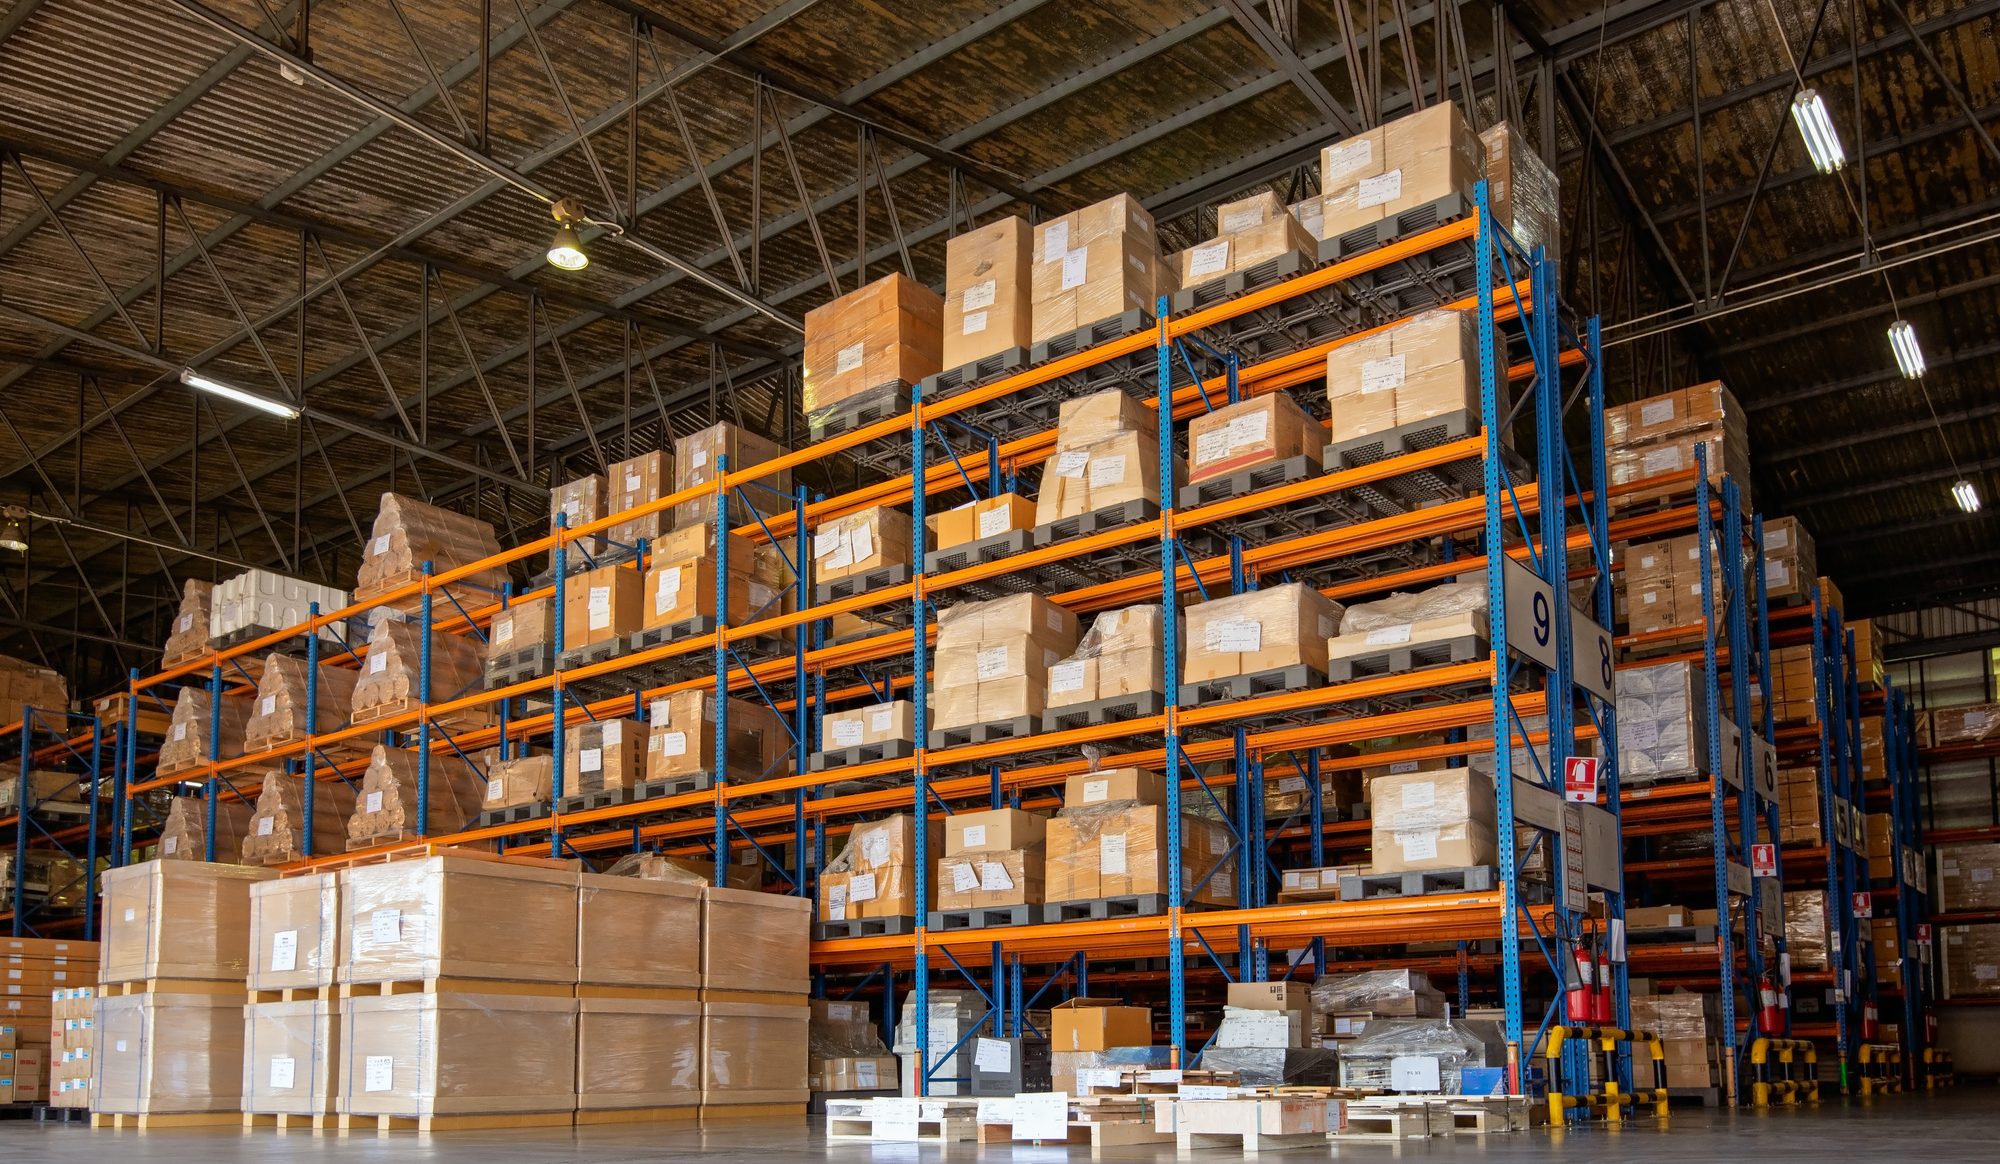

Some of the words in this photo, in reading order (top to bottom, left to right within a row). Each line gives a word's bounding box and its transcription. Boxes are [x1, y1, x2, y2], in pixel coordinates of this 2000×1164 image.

[1533, 591, 1550, 647] 9
[1598, 635, 1612, 690] 8
[1733, 735, 1741, 779] 7
[1764, 750, 1774, 792] 6
